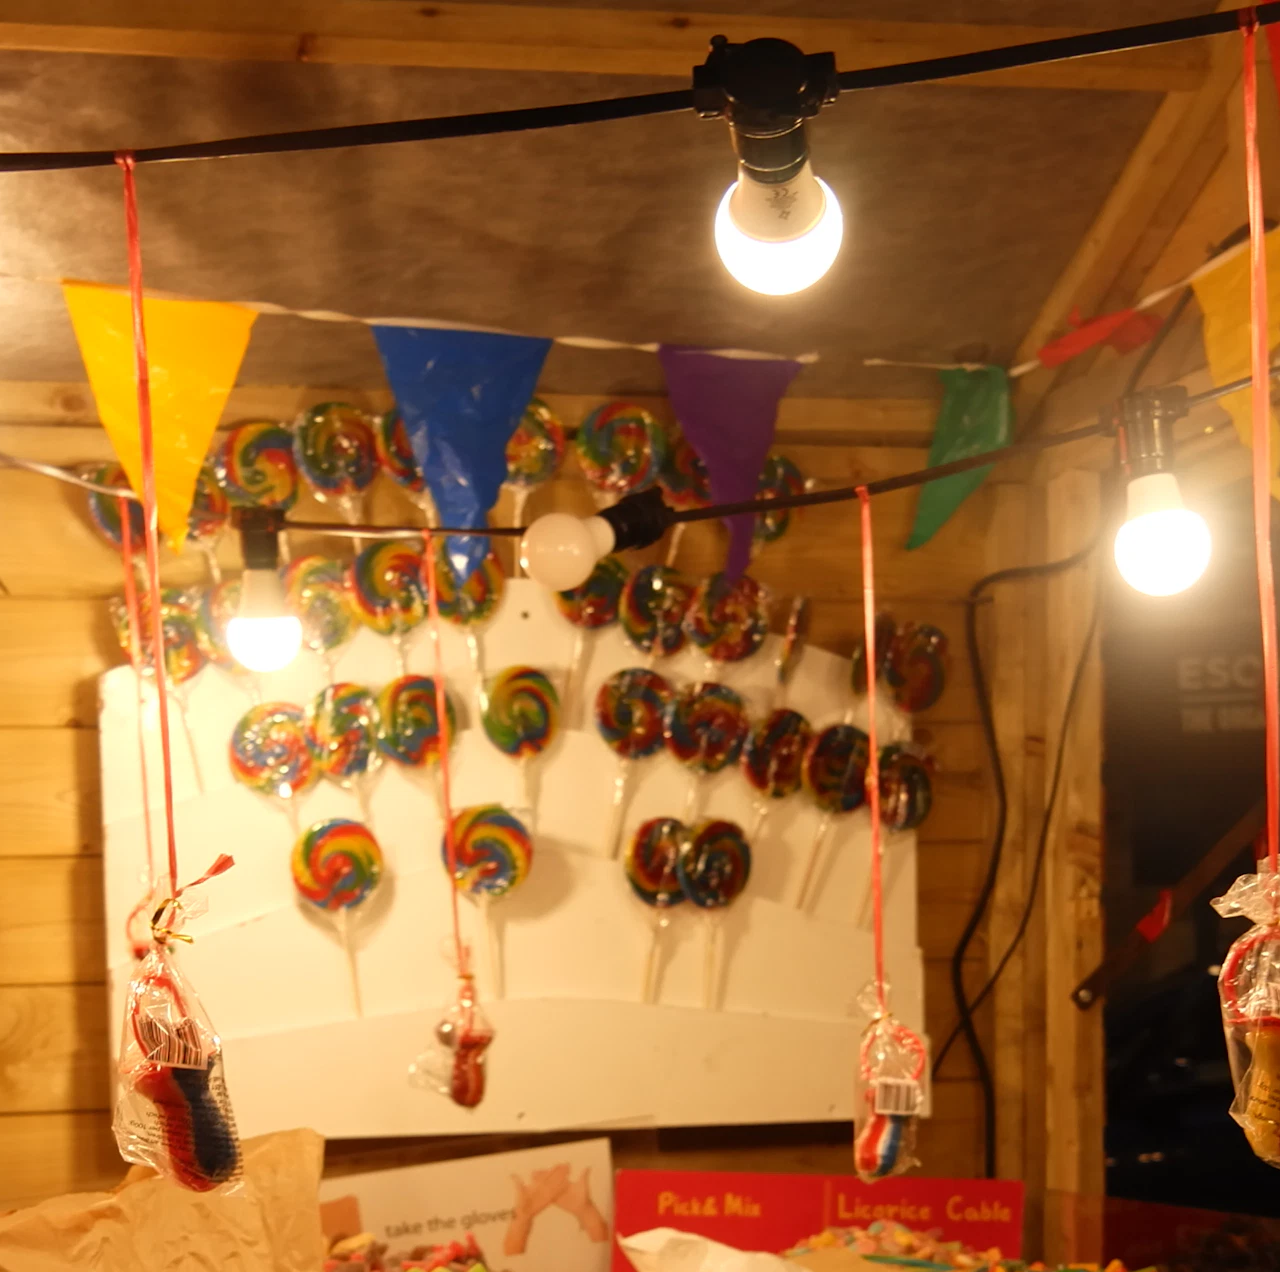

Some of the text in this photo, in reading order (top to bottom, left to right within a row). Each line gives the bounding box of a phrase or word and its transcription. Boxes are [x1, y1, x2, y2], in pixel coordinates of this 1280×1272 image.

[724, 1193, 762, 1218] Mix
[838, 1192, 1013, 1222] Licorice Cable
[384, 1221, 422, 1238] take
[427, 1215, 457, 1232] the
